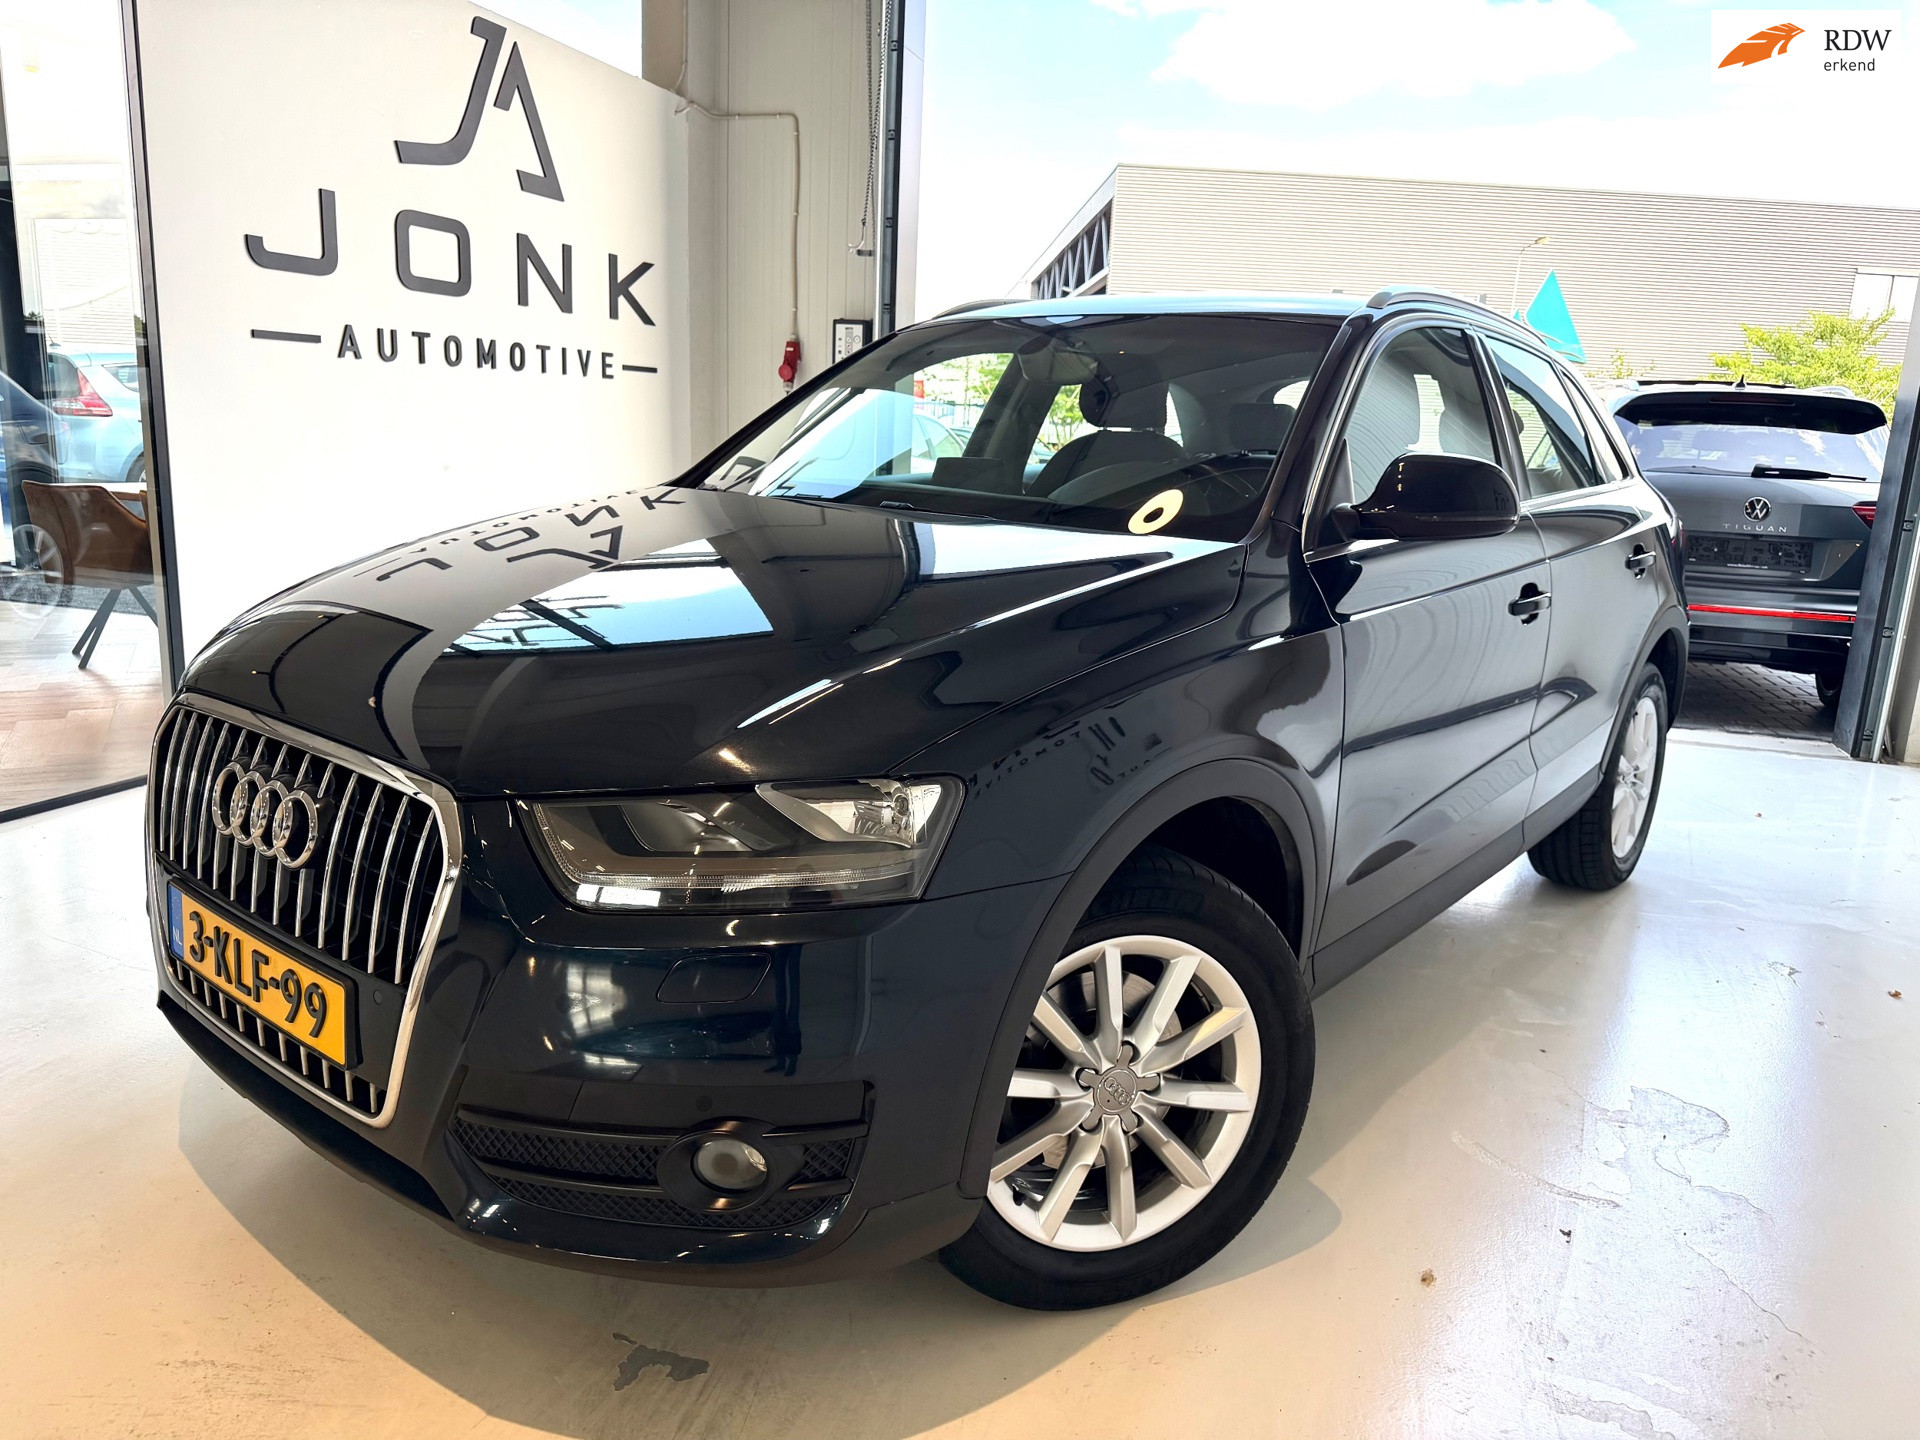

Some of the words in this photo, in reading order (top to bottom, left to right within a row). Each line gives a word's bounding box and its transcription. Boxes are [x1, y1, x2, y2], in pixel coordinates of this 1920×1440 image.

[244, 188, 656, 327] JONK
[337, 323, 615, 380] AUTOMOTIVE
[1722, 522, 1788, 533] TIGUAN
[189, 910, 328, 1039] 3-KLF-99
